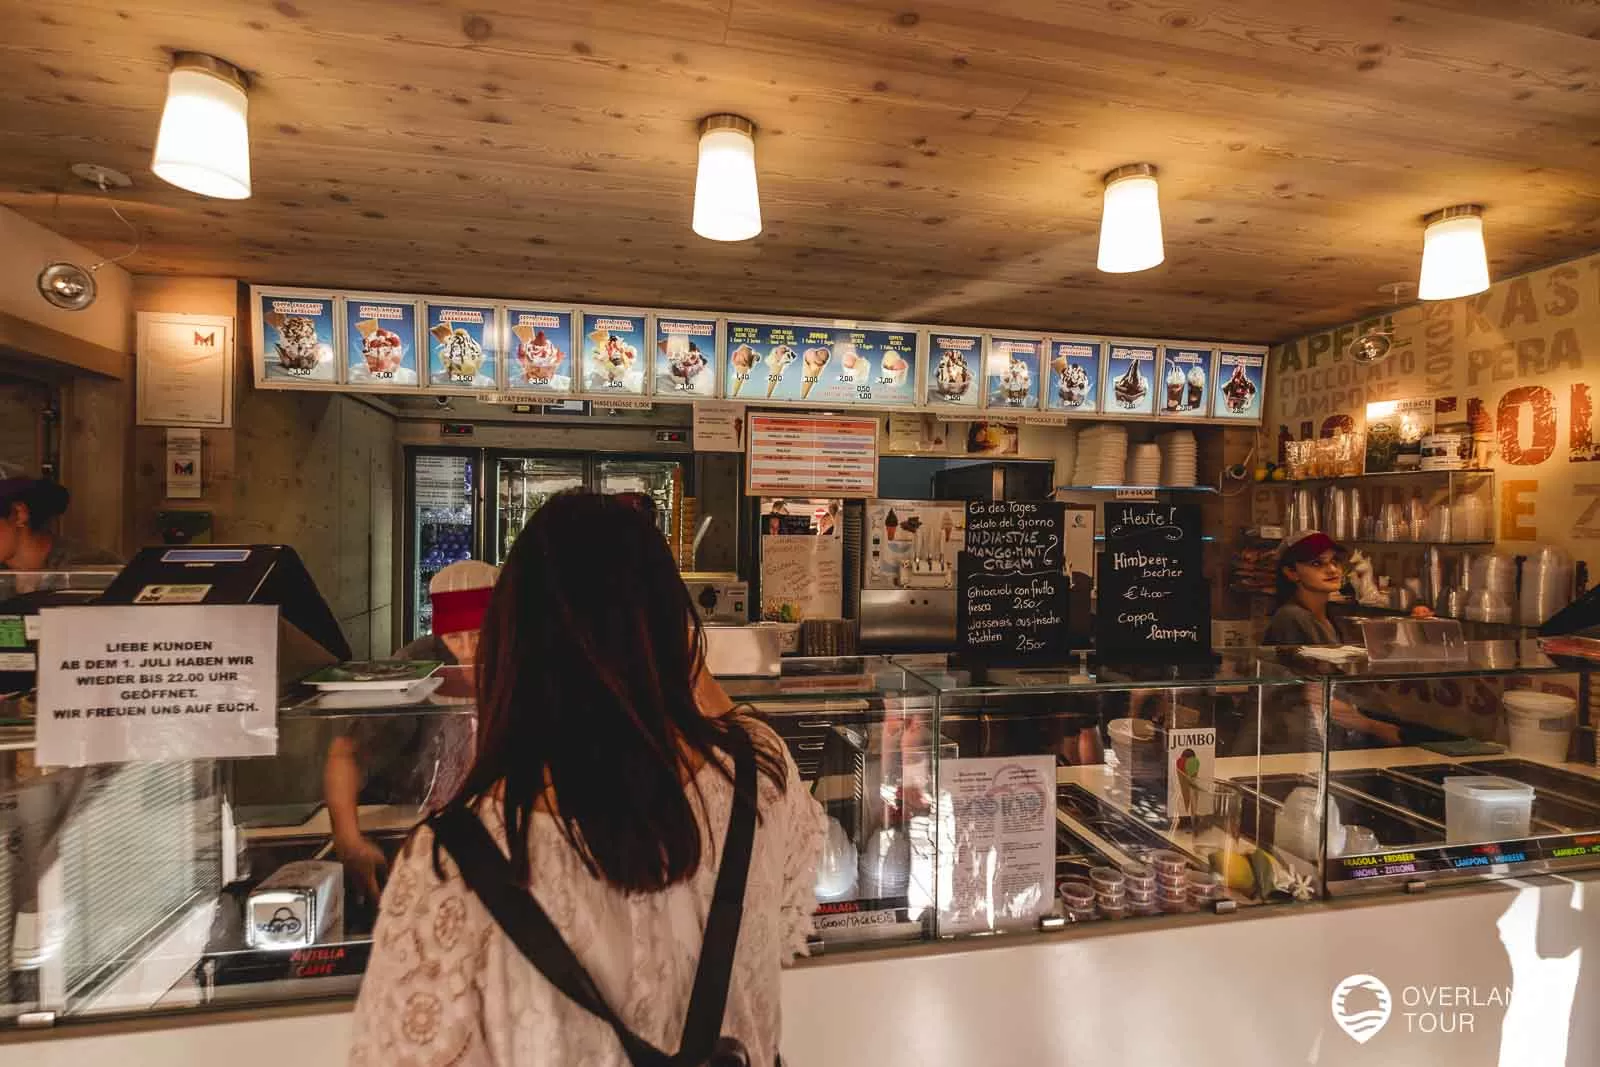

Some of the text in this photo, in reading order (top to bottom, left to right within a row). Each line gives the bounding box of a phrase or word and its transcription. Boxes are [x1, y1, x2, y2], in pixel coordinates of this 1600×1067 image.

[1466, 327, 1584, 386] PERA
[1280, 350, 1416, 396] CIOCCOLATO
[970, 501, 1037, 519] Eis des Tages
[1000, 518, 1014, 527] del
[1017, 519, 1055, 530] giorno
[984, 559, 1033, 570] CREAM
[1143, 568, 1184, 578] becher
[1014, 587, 1030, 596] con
[968, 599, 992, 615] fresca
[106, 641, 212, 652] LIEBE KUNDEN
[60, 655, 254, 670] AB DEM 1. JULI HABEN WIR
[76, 671, 238, 686] WIEDER BIS 22.00 UHR
[120, 687, 198, 700] GEÖFFNET.
[53, 702, 259, 719] WIR FREUEN UNS AUF EUCH.
[1170, 733, 1215, 749] JUMBO
